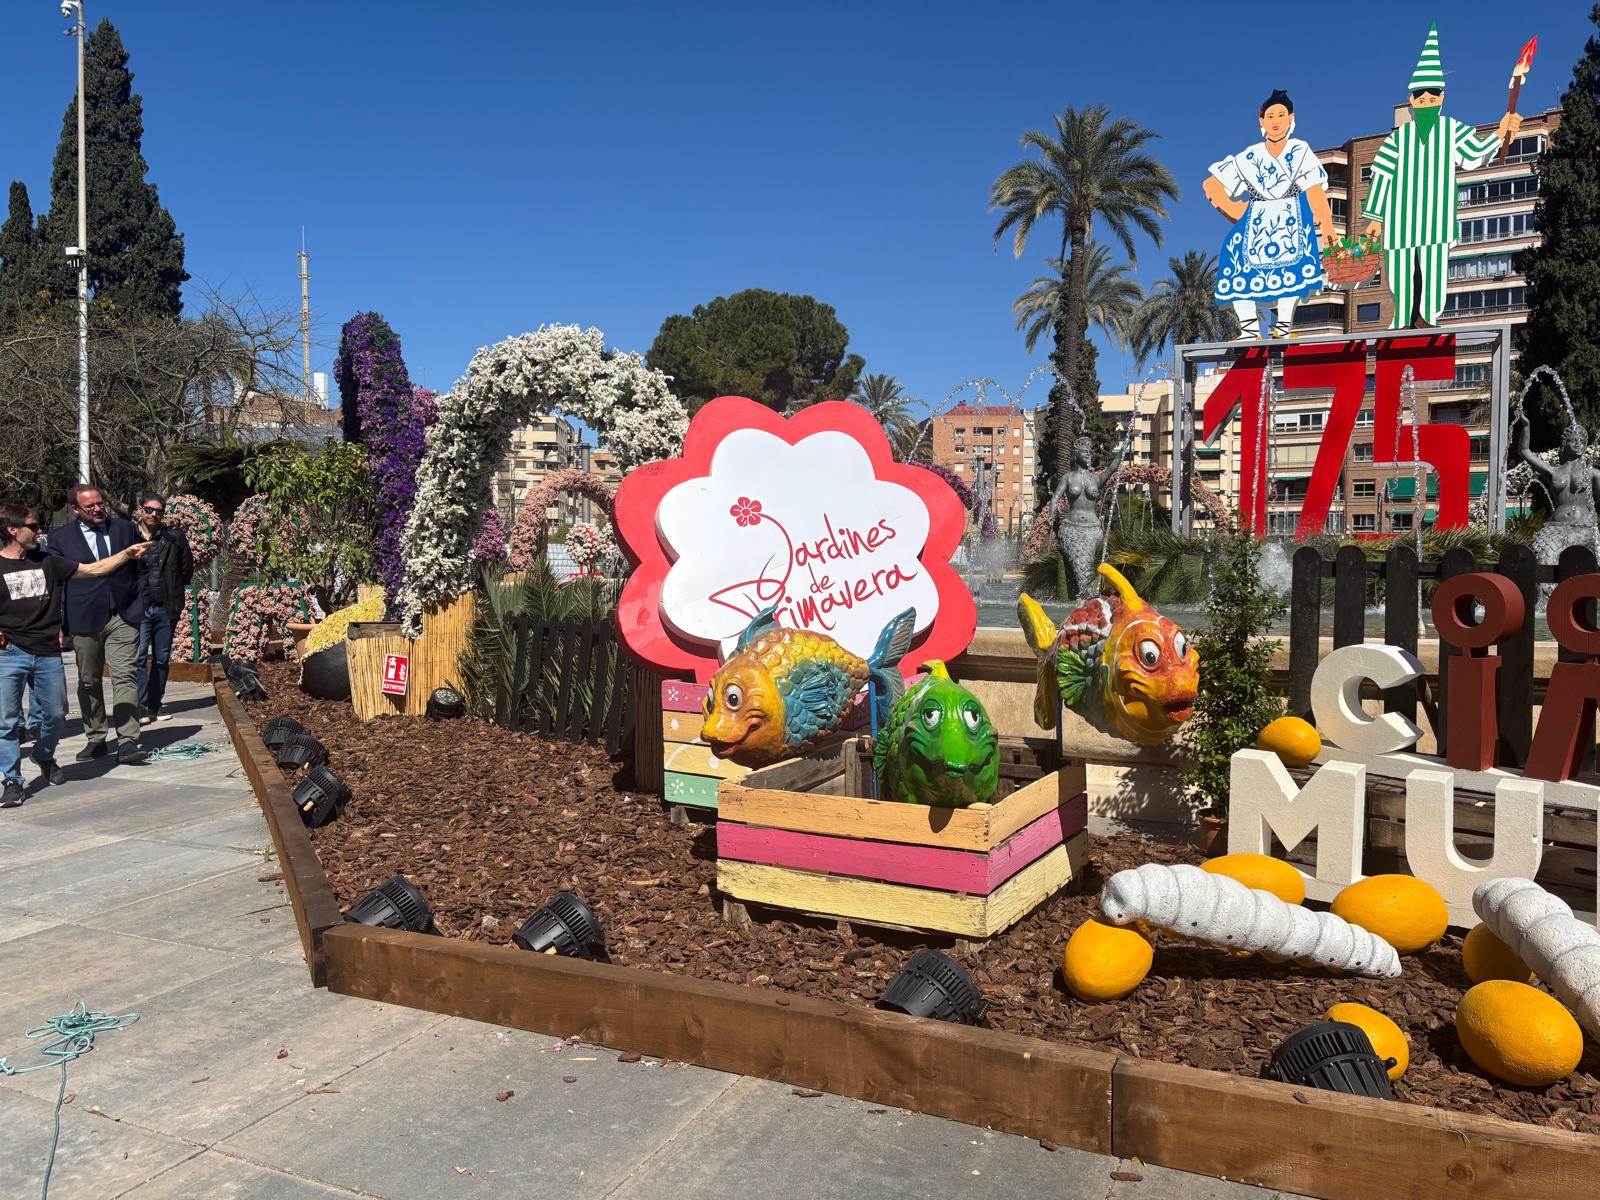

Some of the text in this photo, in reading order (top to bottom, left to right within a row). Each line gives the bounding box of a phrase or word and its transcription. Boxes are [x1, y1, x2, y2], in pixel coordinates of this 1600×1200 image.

[1203, 334, 1470, 538] 175
[757, 512, 896, 600] Jardines
[808, 562, 835, 594] de
